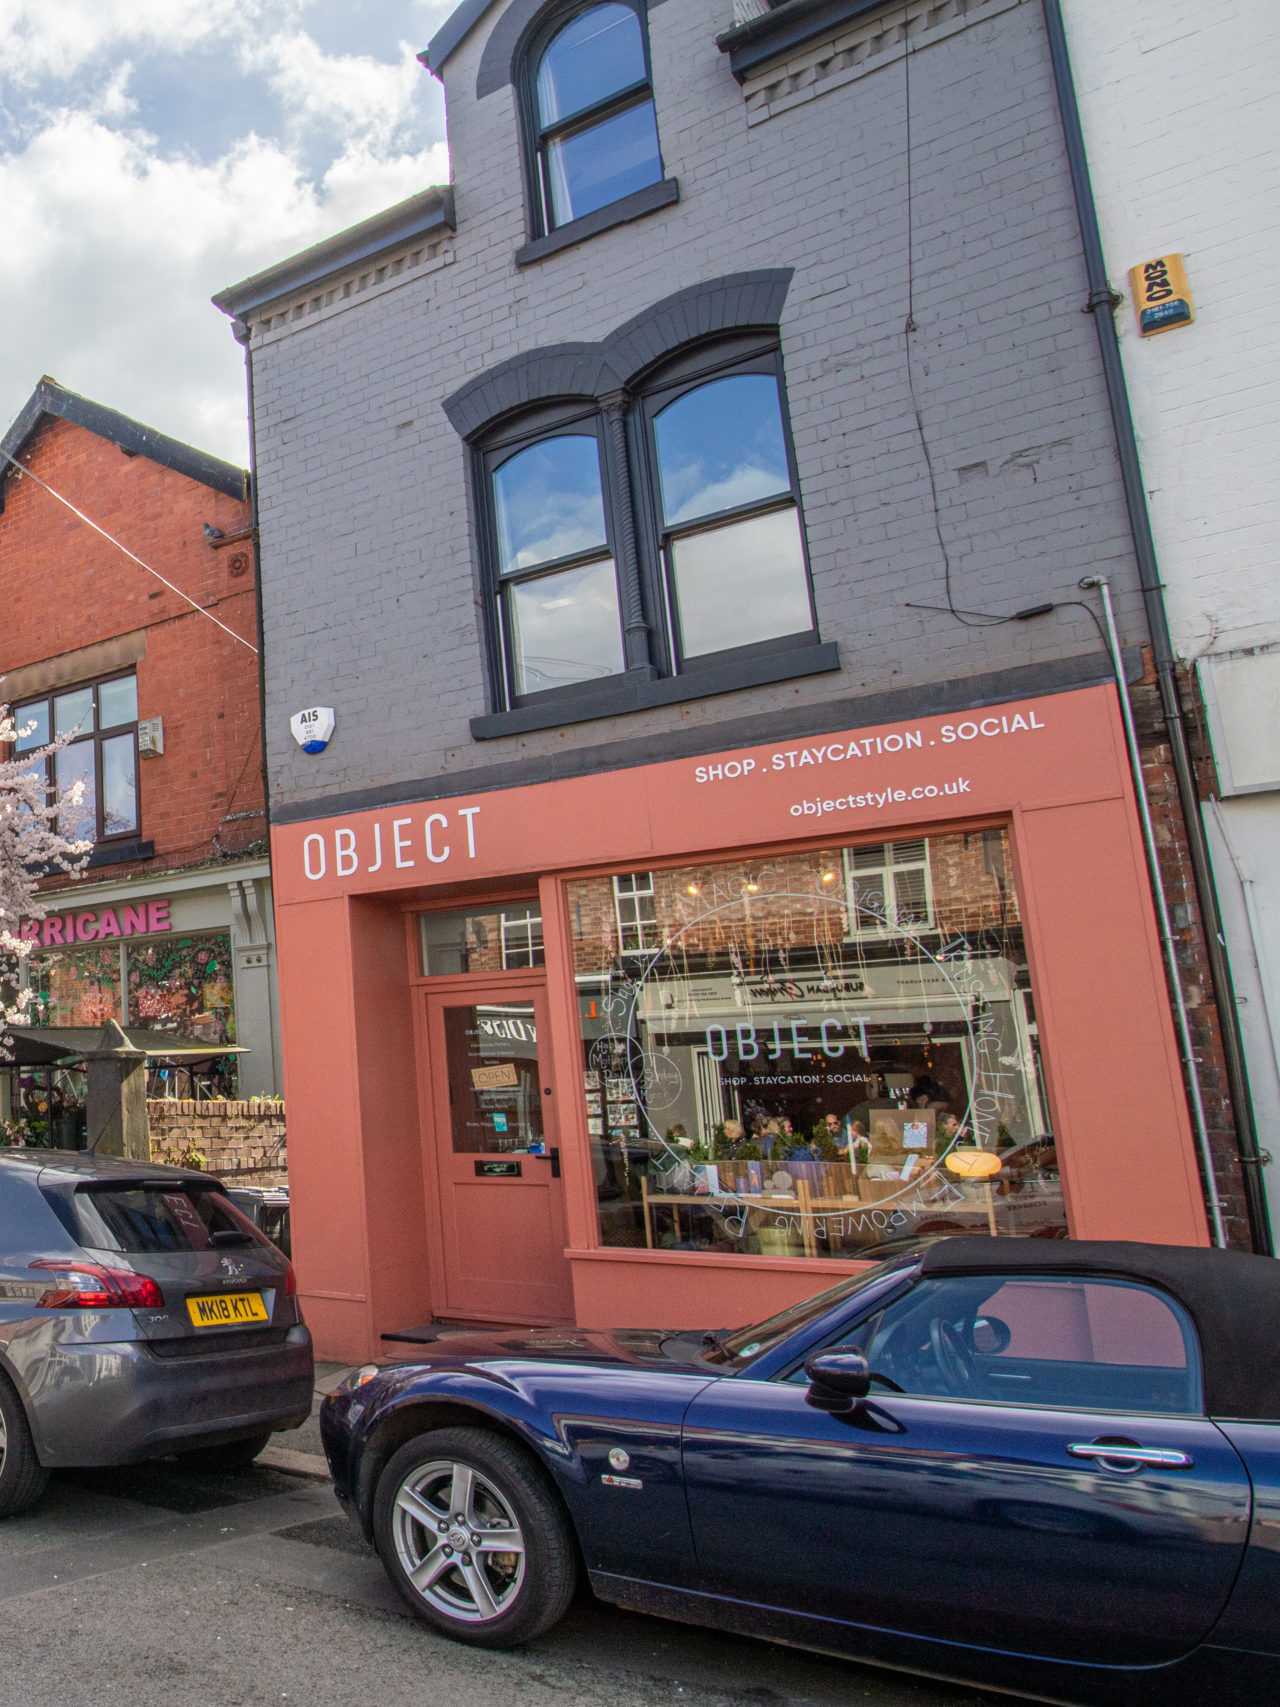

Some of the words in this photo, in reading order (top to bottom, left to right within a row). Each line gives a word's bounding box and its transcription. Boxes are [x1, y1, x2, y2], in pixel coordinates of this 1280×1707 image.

[695, 758, 756, 783] SHOP
[771, 731, 923, 771] STAYCATION
[940, 711, 1045, 744] SOCIAL
[790, 778, 971, 817] objectstyle.co.uk
[303, 807, 481, 880] OBJECT
[705, 1016, 871, 1061] OBJECT
[477, 1069, 511, 1084] OPEN
[719, 1077, 747, 1086] SHOP
[754, 1075, 820, 1085] STAYCATION
[827, 1074, 869, 1083] SOCIAL
[196, 1299, 231, 1322] MK18
[232, 1297, 259, 1319] KTL
